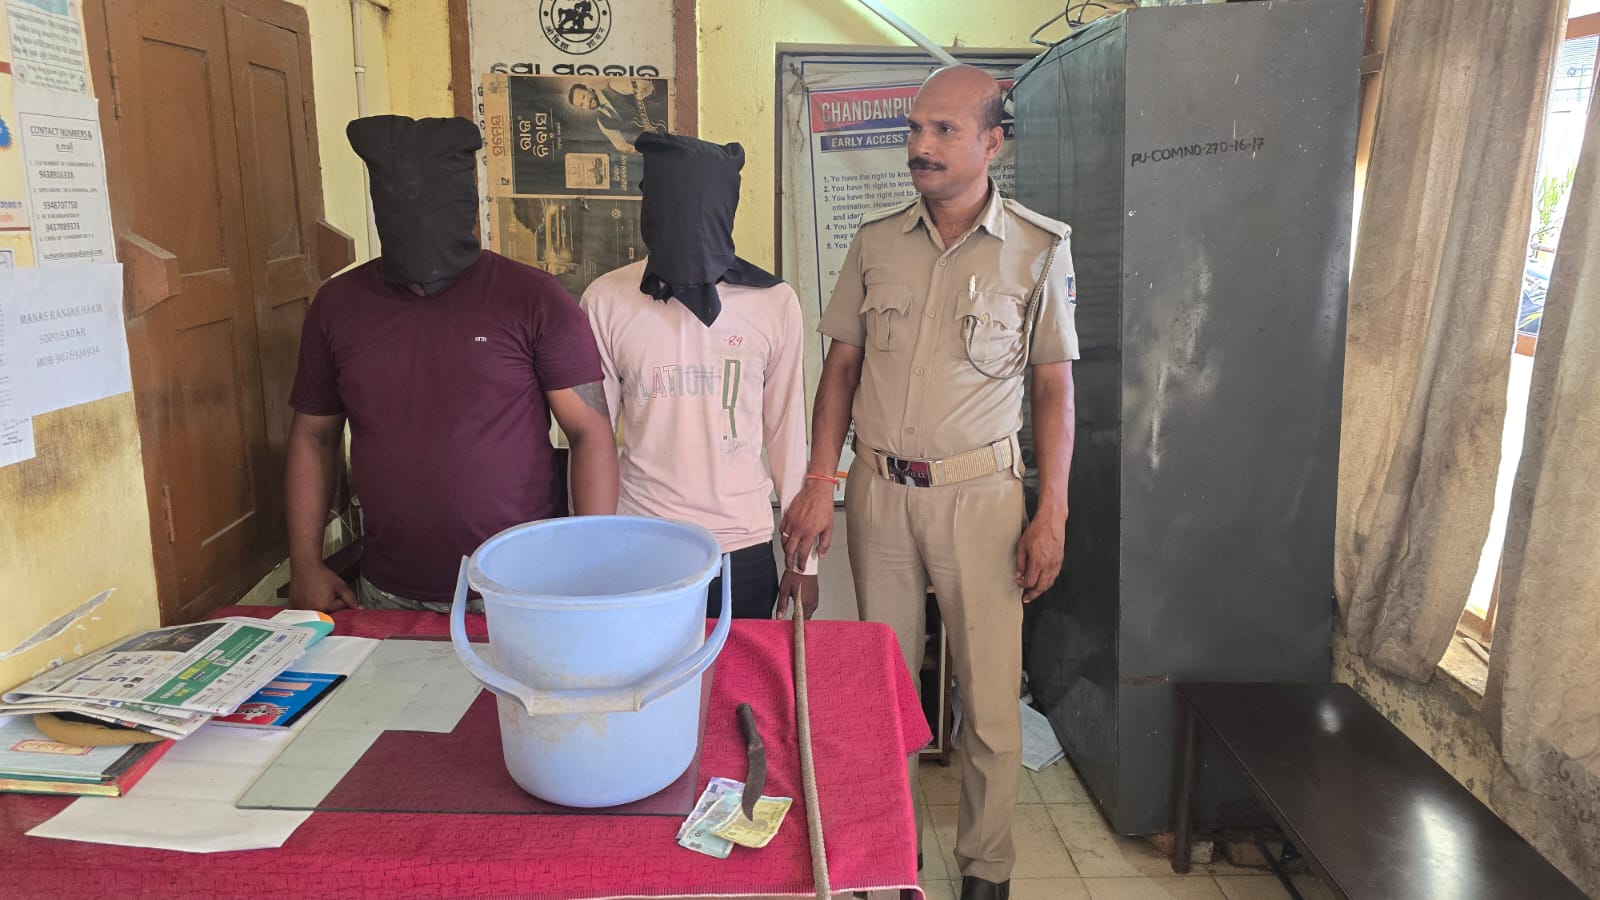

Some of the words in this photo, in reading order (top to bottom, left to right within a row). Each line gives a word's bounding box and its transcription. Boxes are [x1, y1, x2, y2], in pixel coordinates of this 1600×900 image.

[821, 95, 916, 123] CHANDANPU
[30, 125, 59, 136] CONTACT
[831, 136, 863, 148] EARLY
[865, 133, 904, 145] ACCESS
[841, 174, 858, 182] have
[871, 172, 887, 182] right
[872, 182, 888, 191] right
[876, 191, 892, 201] right
[19, 311, 49, 325] MANAS
[50, 306, 80, 321] RANJAN
